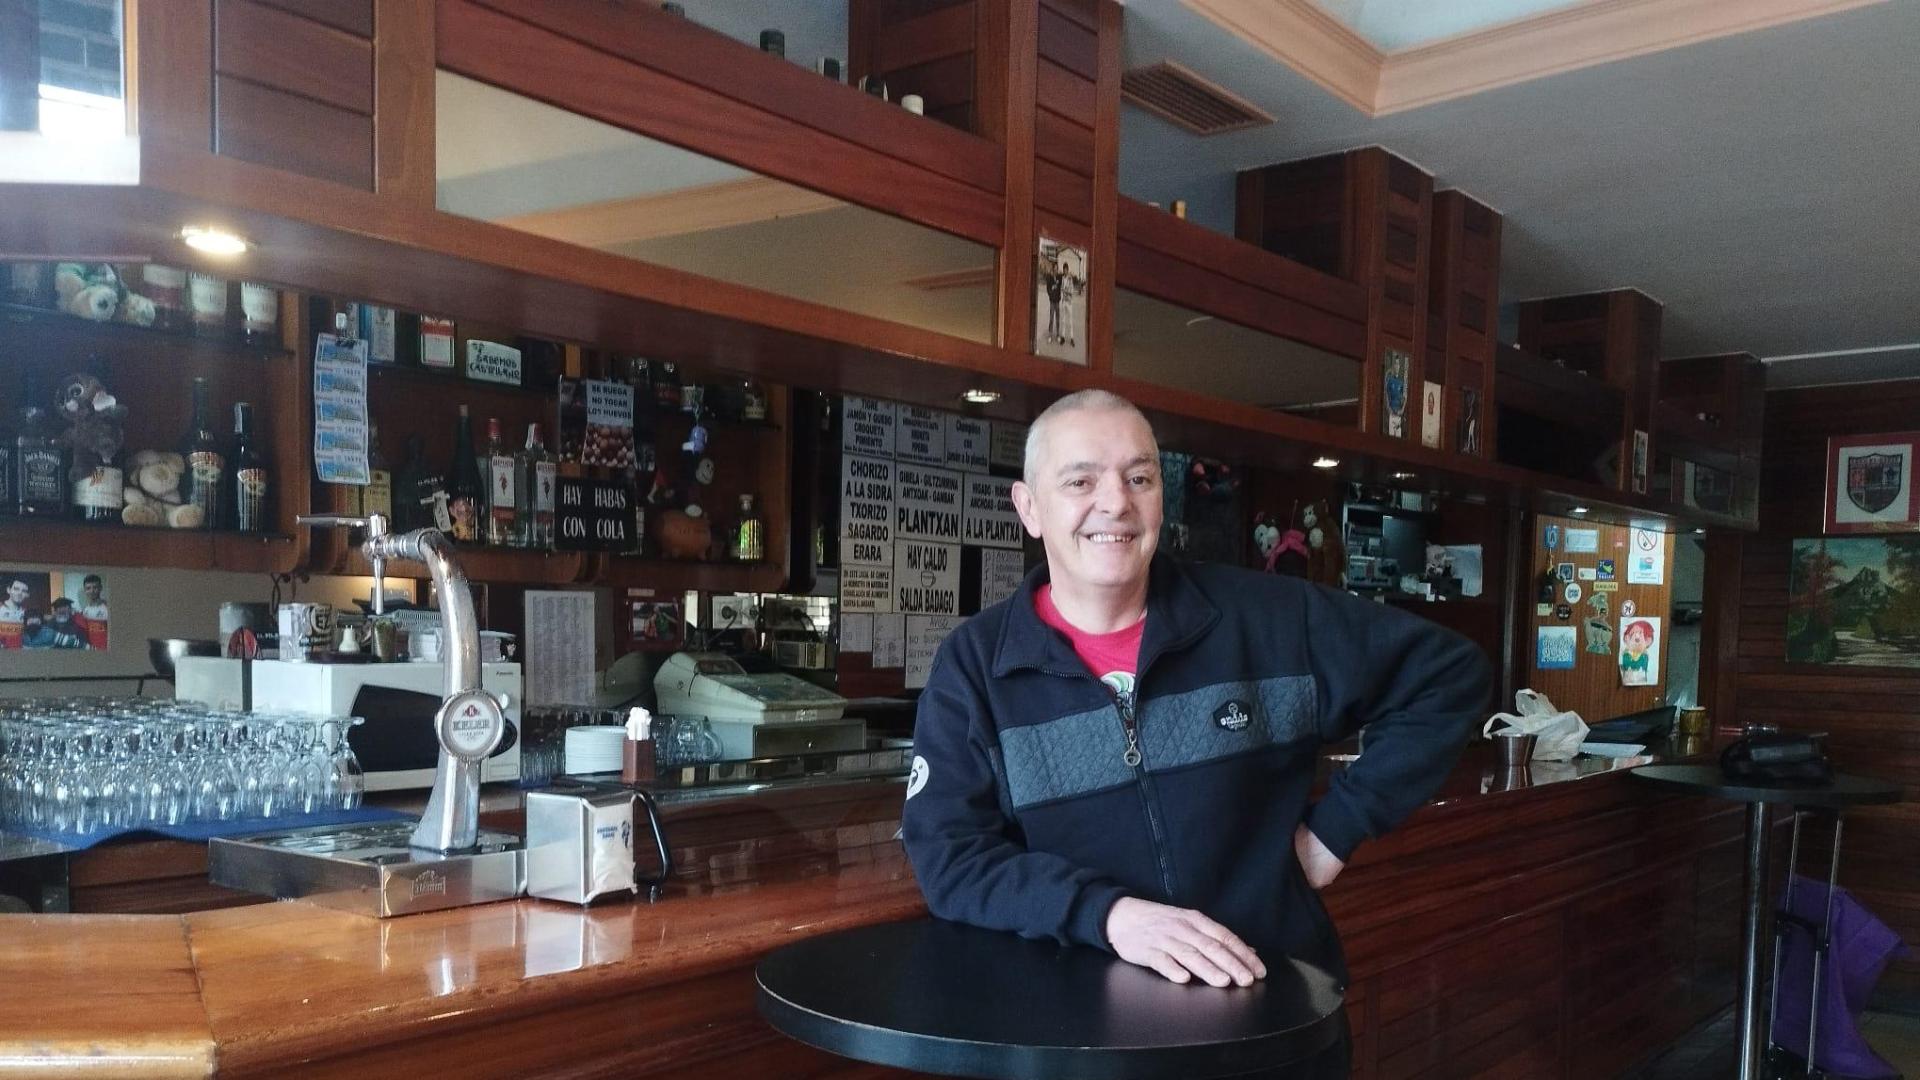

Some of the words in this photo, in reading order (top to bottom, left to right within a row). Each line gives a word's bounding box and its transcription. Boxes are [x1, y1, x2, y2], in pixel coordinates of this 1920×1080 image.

[592, 396, 602, 405] NO
[603, 385, 628, 397] RUEGA
[603, 409, 632, 420] HUEVOS
[854, 422, 884, 437] CROQUETA
[856, 435, 883, 448] PIMIENTO
[850, 460, 889, 481] CHORIZO
[563, 484, 582, 506] HAY
[594, 487, 626, 509] HABAS
[846, 480, 852, 497] A
[854, 481, 865, 498] LA
[867, 483, 893, 502] SIDRA
[850, 502, 888, 523] TXORIZO
[898, 506, 959, 538] PLANTXAN
[563, 516, 586, 538] CON
[596, 518, 625, 541] COLA
[847, 522, 889, 542] SAGARDO
[965, 516, 972, 538] A
[973, 517, 984, 540] LA
[985, 519, 1021, 543] PLANTXA
[853, 543, 882, 562] ERARA
[907, 544, 923, 570] HAY
[923, 546, 948, 572] CALDO
[899, 587, 923, 613] SALDA
[925, 589, 954, 614] BADAGO
